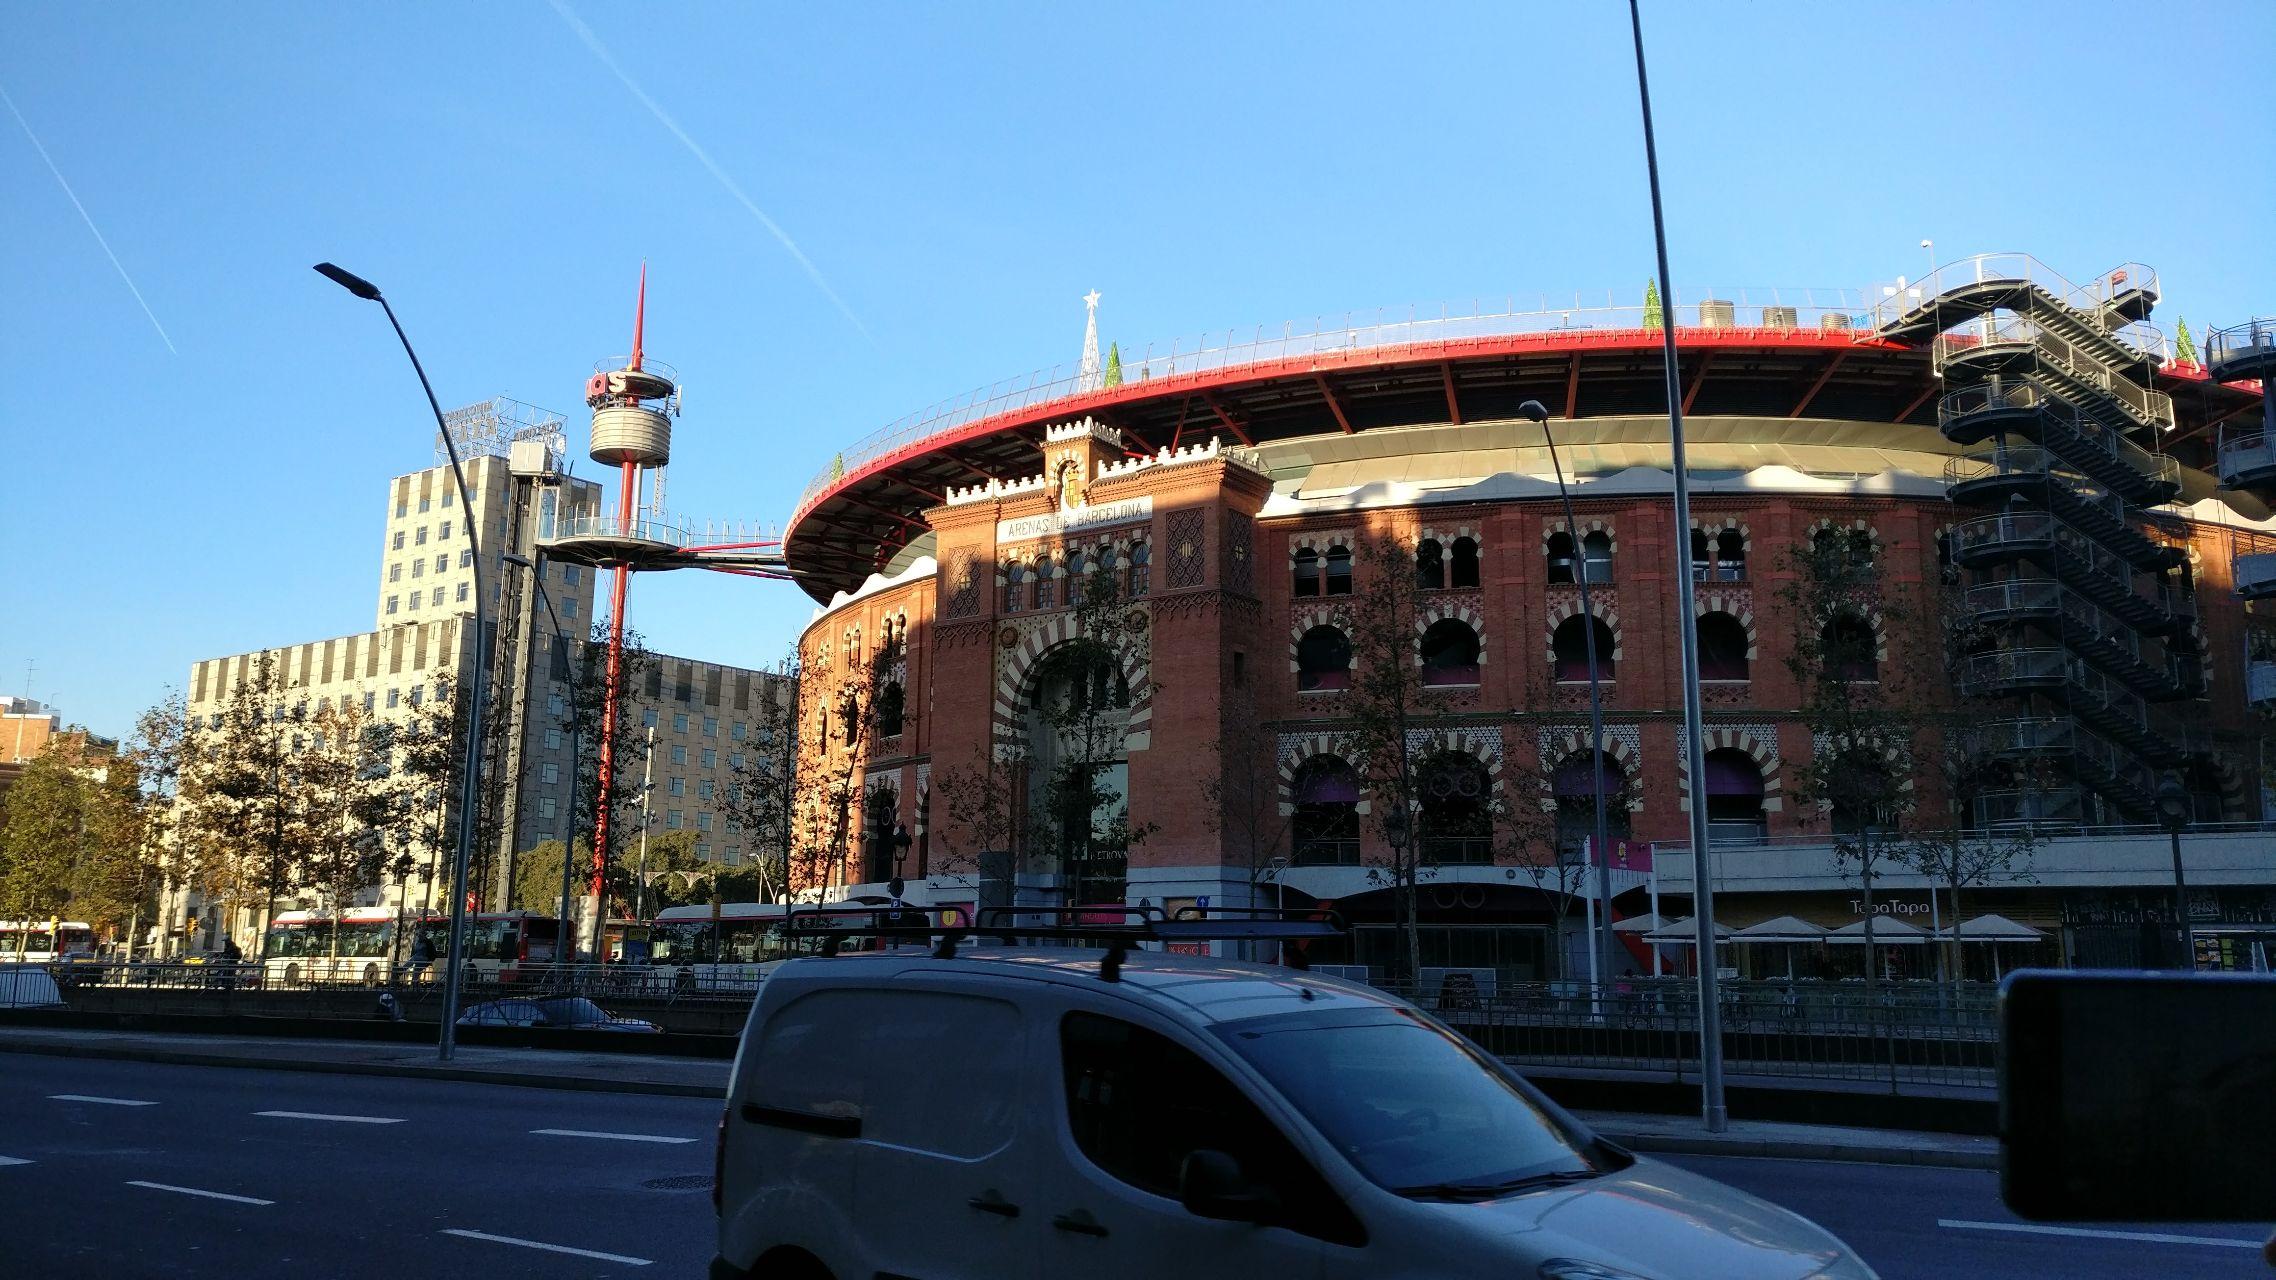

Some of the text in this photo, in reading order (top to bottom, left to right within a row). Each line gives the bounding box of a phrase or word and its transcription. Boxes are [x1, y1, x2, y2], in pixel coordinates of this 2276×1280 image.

[1008, 503, 1143, 537] ARENAS DE BARCELONA
